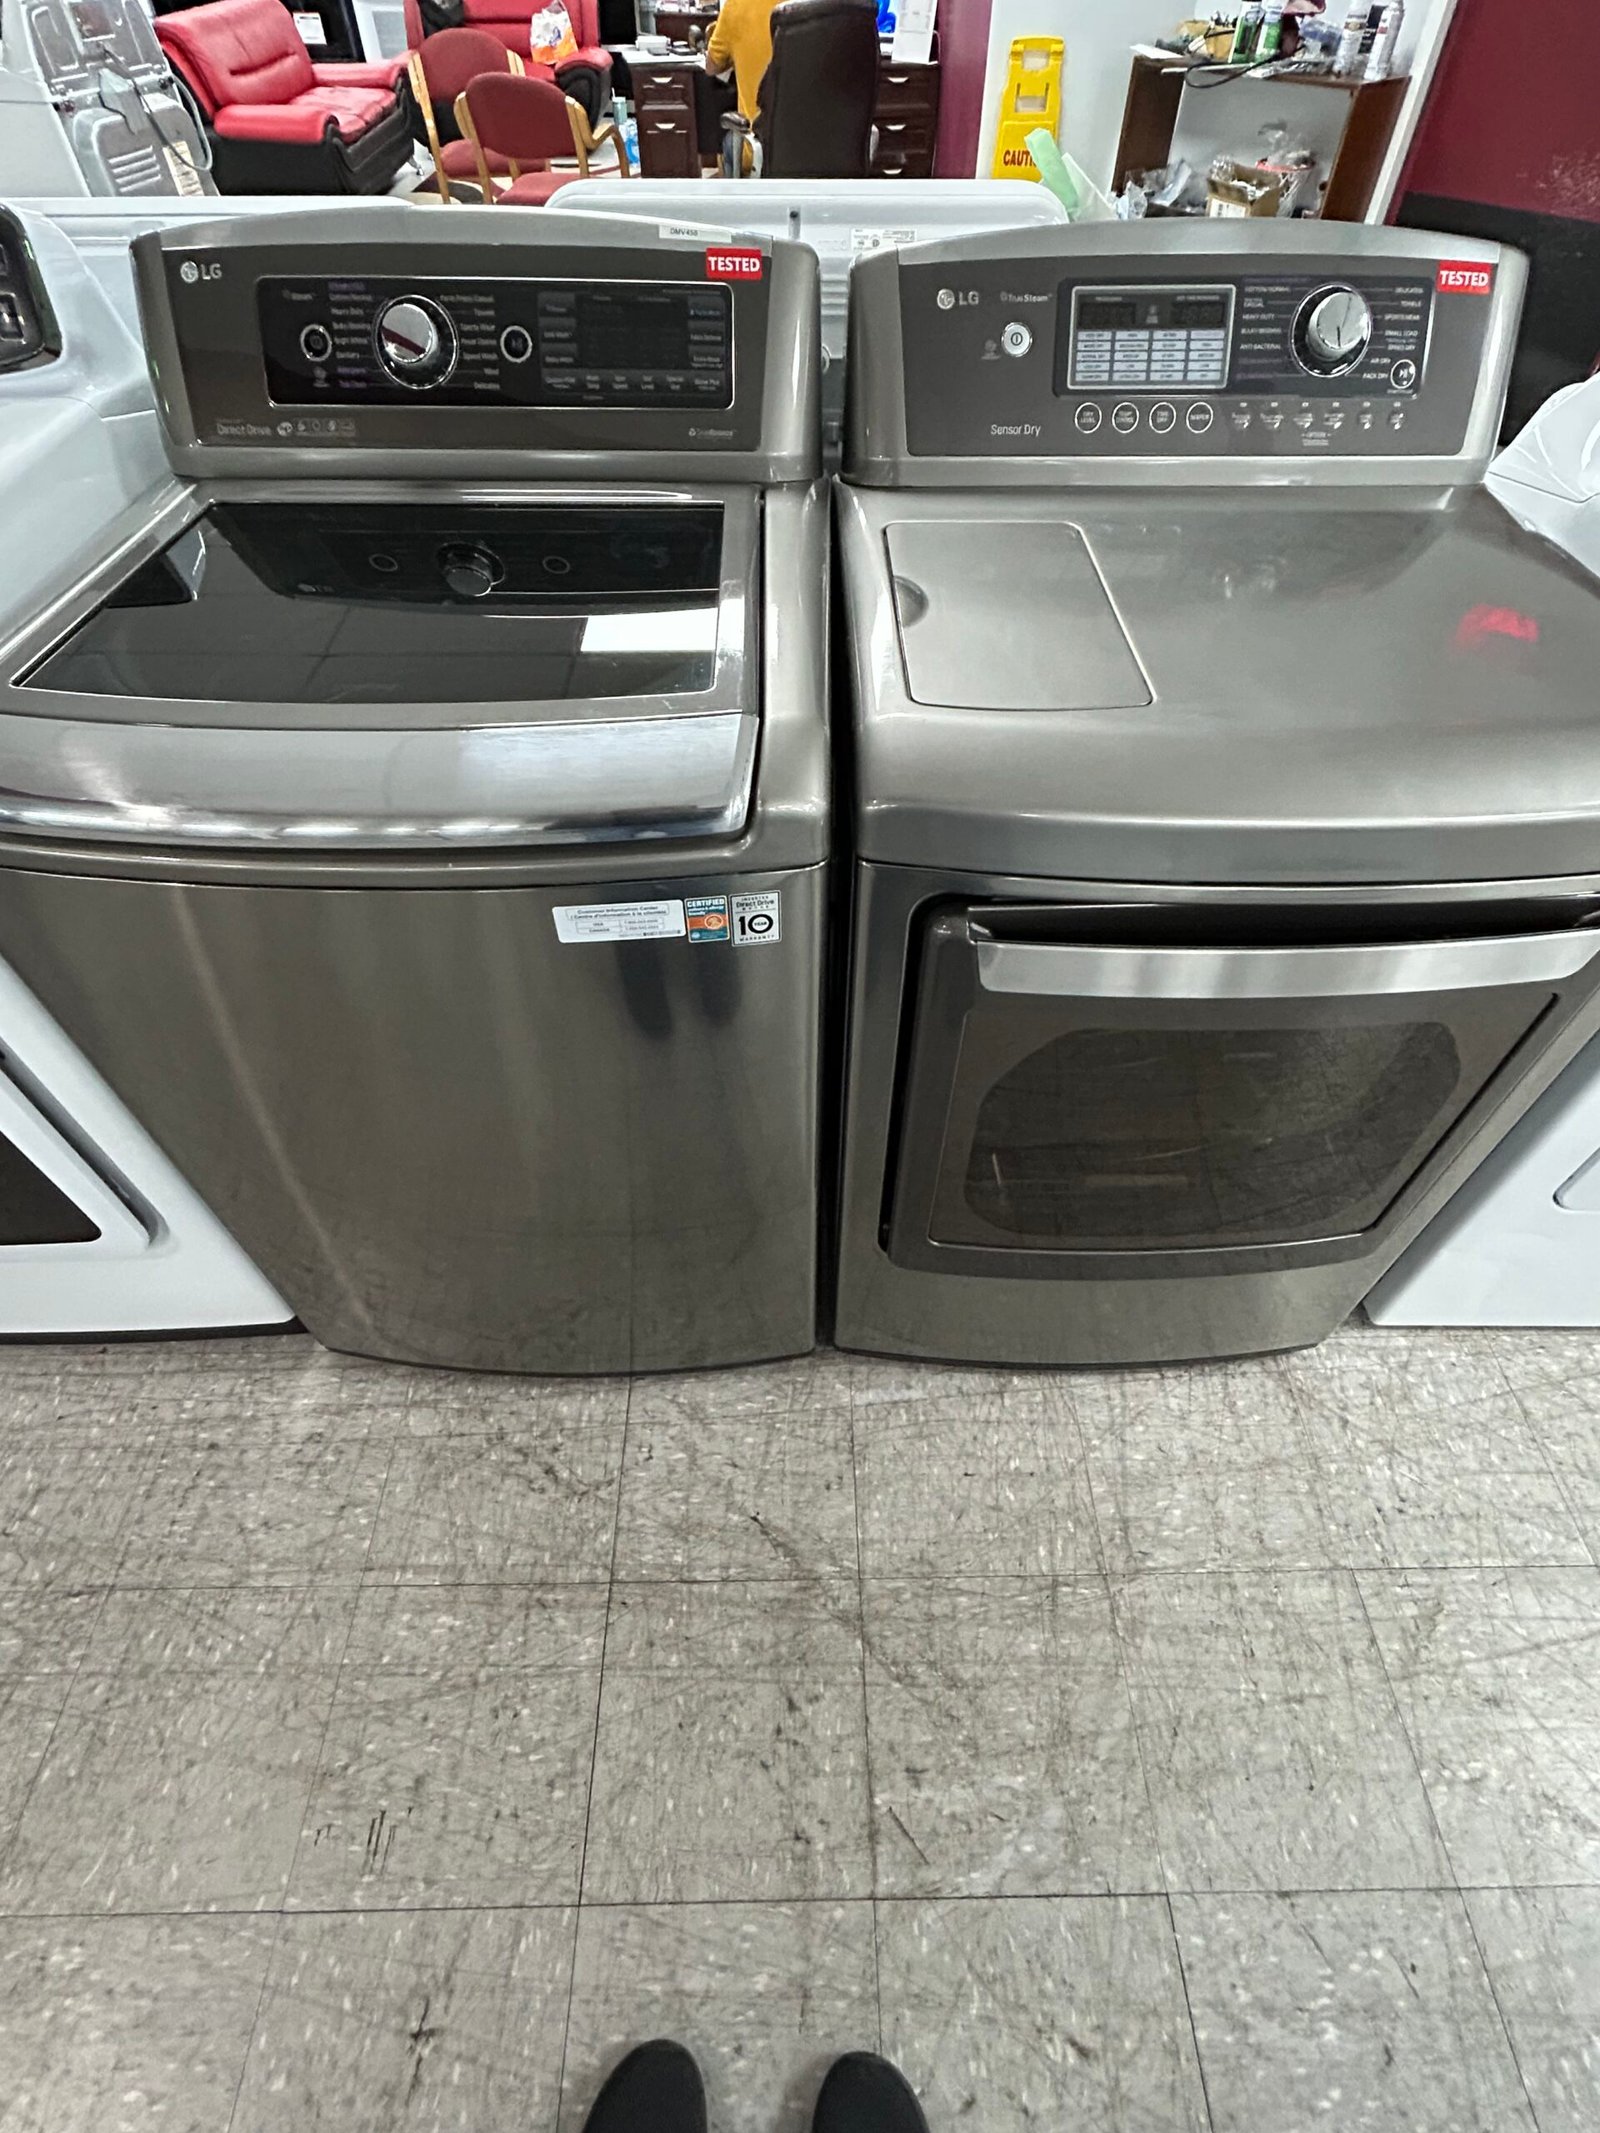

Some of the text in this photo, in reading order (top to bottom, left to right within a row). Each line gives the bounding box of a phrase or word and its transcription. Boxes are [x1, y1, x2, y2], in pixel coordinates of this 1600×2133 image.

[1003, 149, 1037, 167] CAUTI
[201, 263, 222, 279] LG
[708, 256, 760, 272] TESTED
[1440, 270, 1489, 287] TESTED
[958, 291, 979, 305] LG
[991, 424, 1041, 437] Sensor Dry
[687, 898, 725, 908] CERTIFIED
[736, 901, 756, 909] Direct
[739, 914, 774, 935] 10
